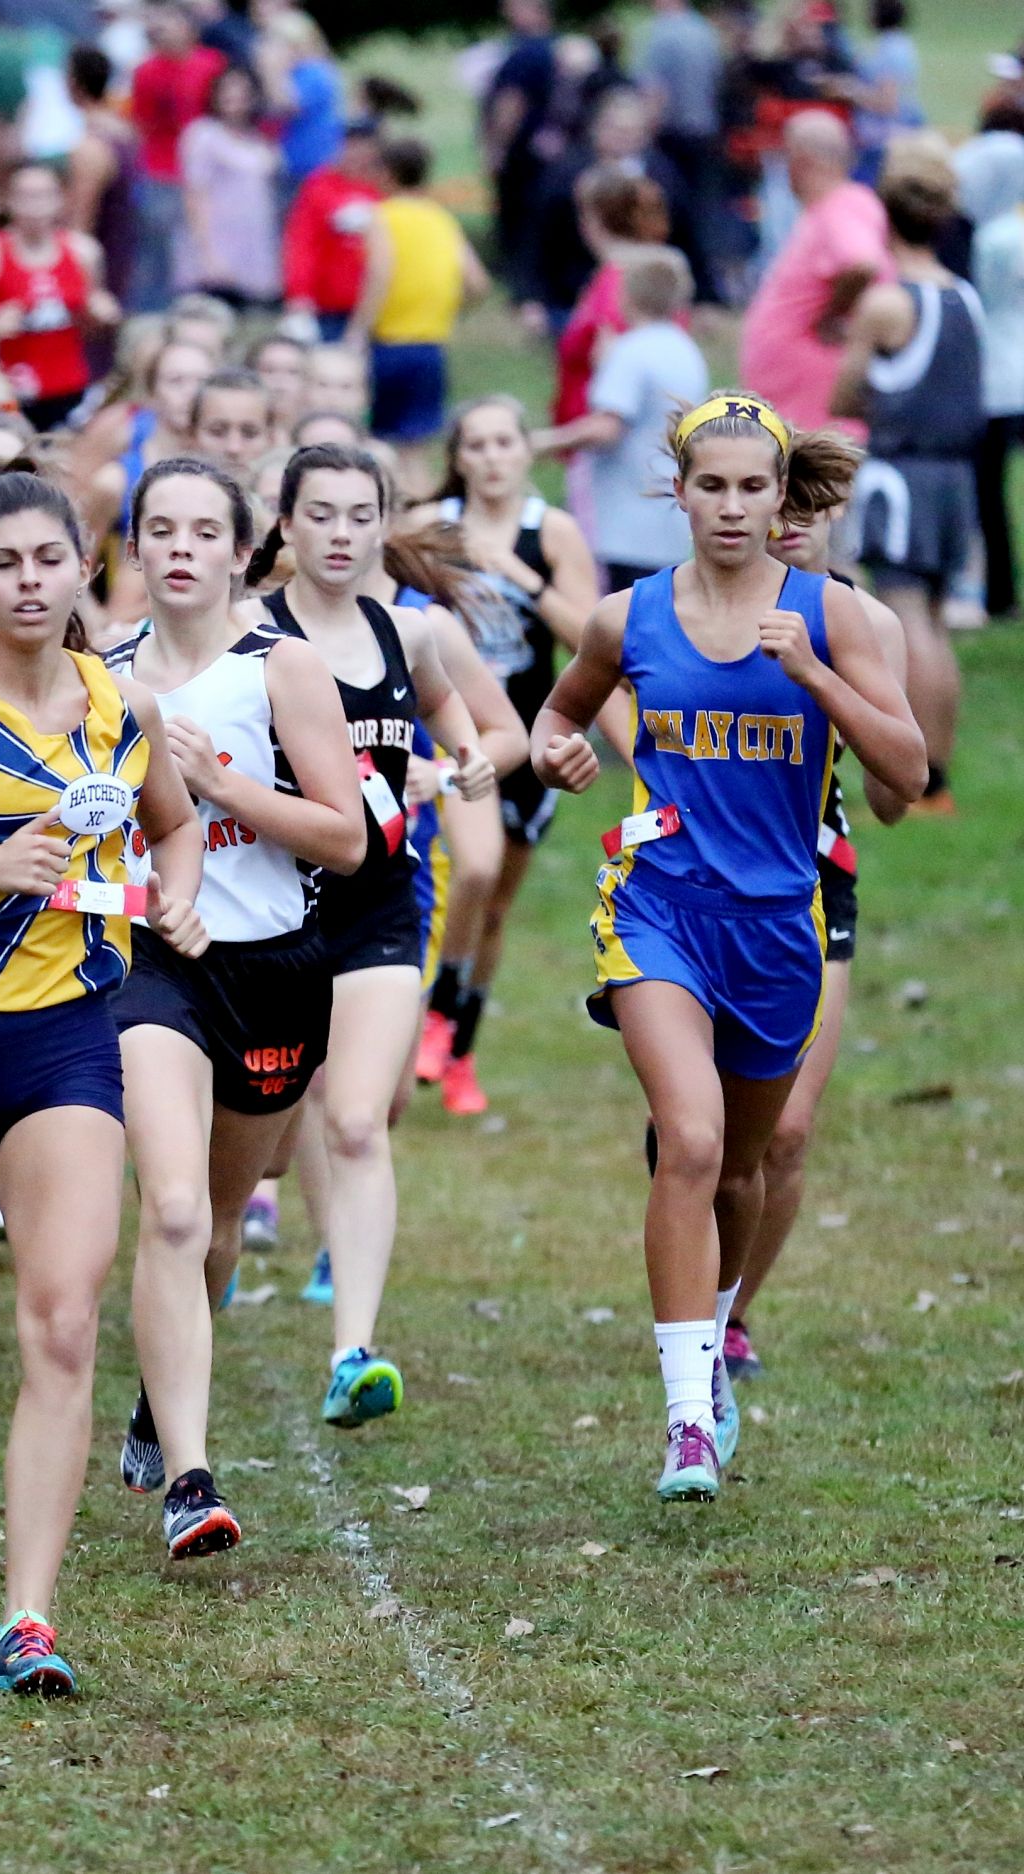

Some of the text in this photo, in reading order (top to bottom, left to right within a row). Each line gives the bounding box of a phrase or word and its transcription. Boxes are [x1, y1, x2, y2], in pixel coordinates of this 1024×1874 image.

[381, 718, 415, 753] BEA
[738, 713, 804, 765] CITY
[69, 784, 127, 809] HATCHETS
[85, 810, 105, 827] XC
[244, 1042, 305, 1072] UBLY
